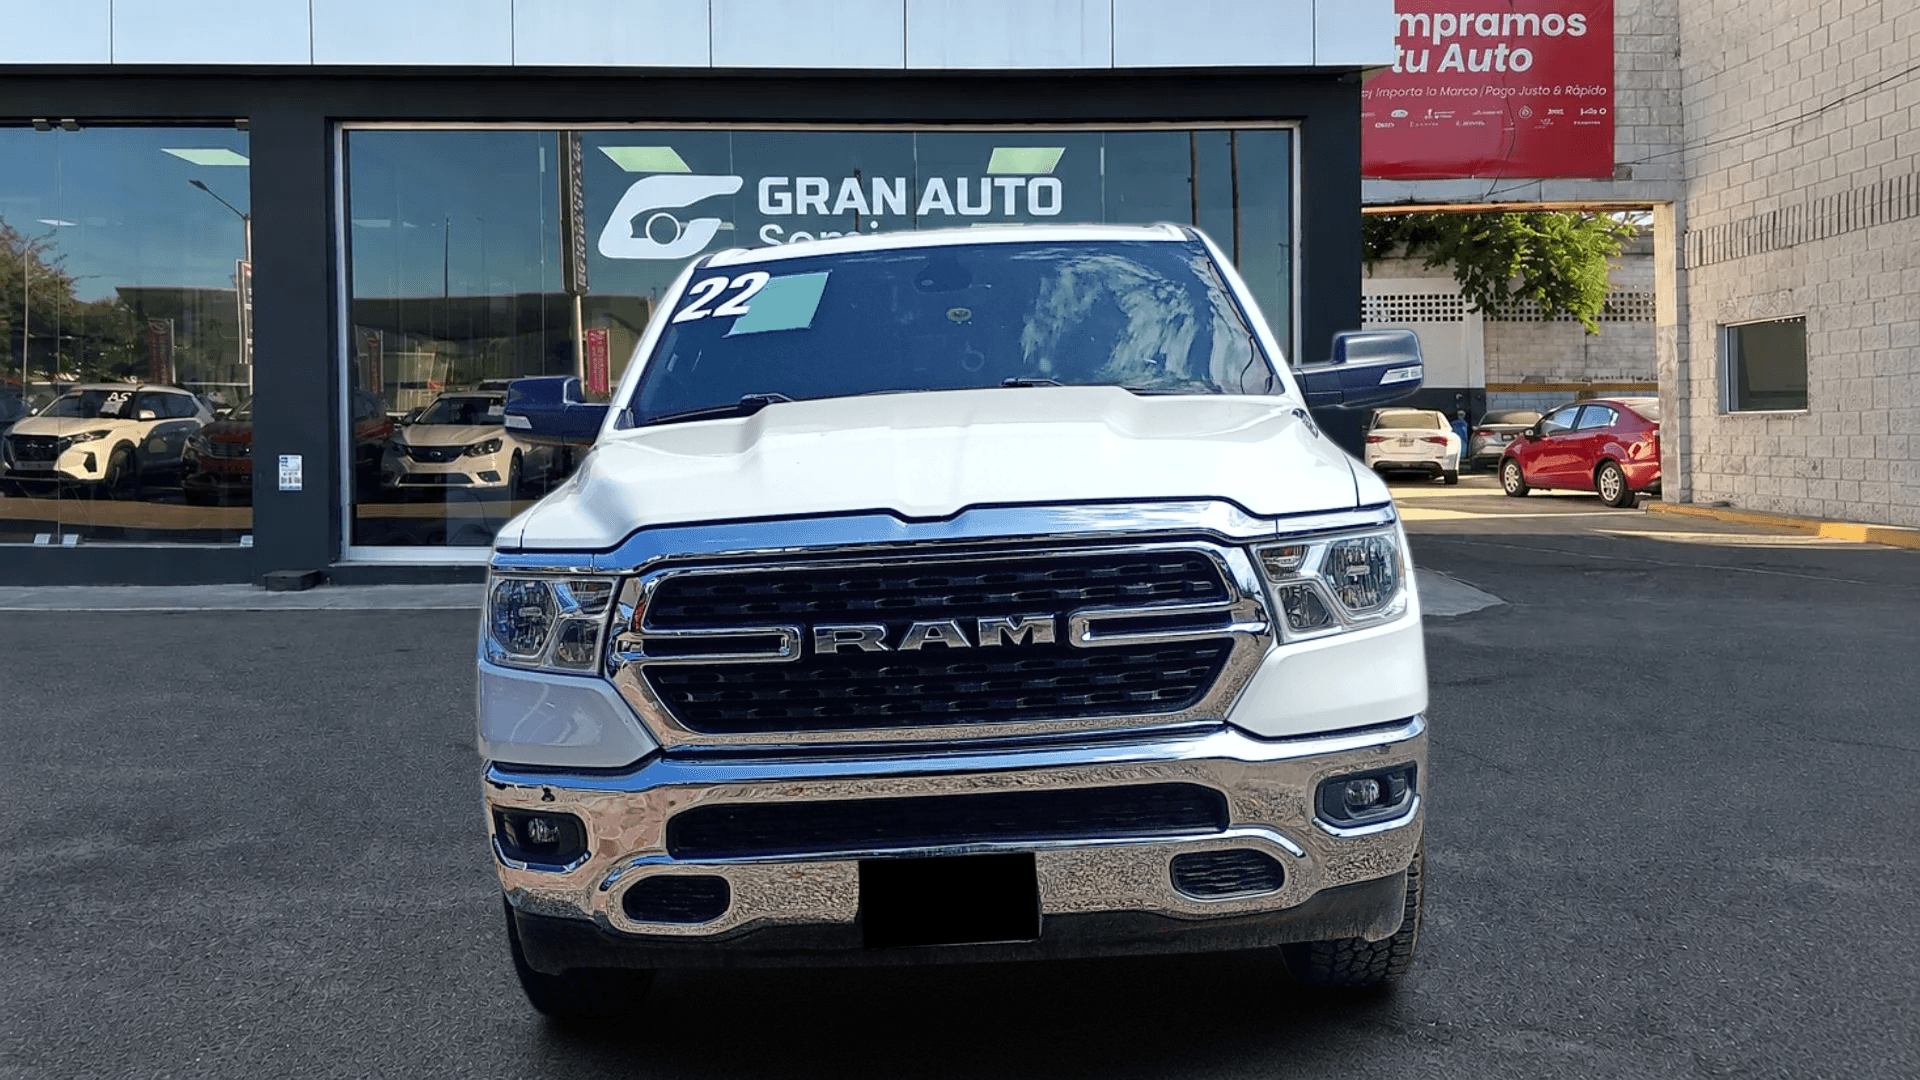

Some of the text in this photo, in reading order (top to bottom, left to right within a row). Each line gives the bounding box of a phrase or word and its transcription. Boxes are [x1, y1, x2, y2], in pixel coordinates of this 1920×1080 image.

[1392, 43, 1533, 73] tu Auto
[1375, 86, 1424, 100] Importa
[1519, 86, 1551, 96] Justo
[758, 176, 1063, 217] GRAN AUTO
[672, 271, 770, 324] 22
[812, 613, 1056, 655] RAM
